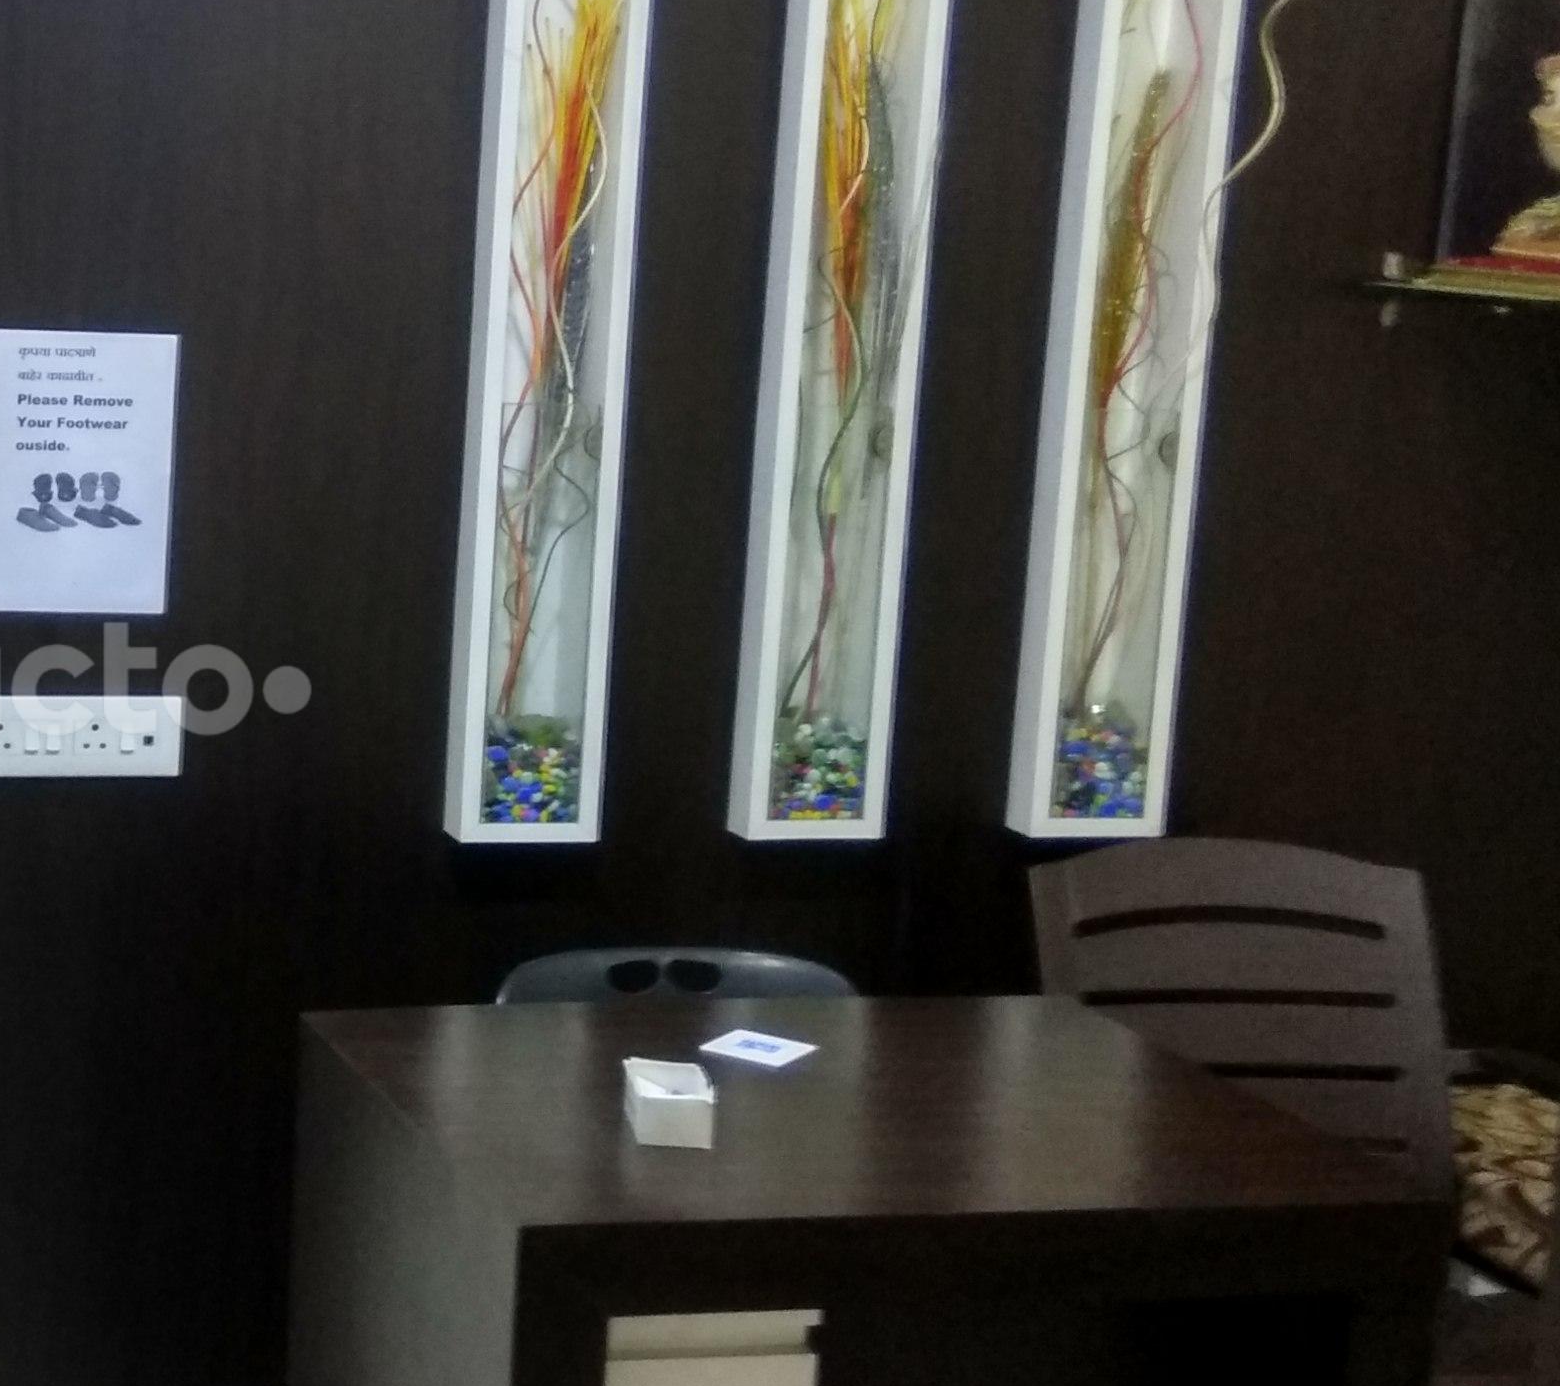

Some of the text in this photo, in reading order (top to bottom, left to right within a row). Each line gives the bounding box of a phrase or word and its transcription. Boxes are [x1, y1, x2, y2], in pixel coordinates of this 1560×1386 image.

[17, 393, 134, 407] Please Remove
[16, 416, 128, 430] Your Footwear
[15, 439, 71, 451] ouside.
